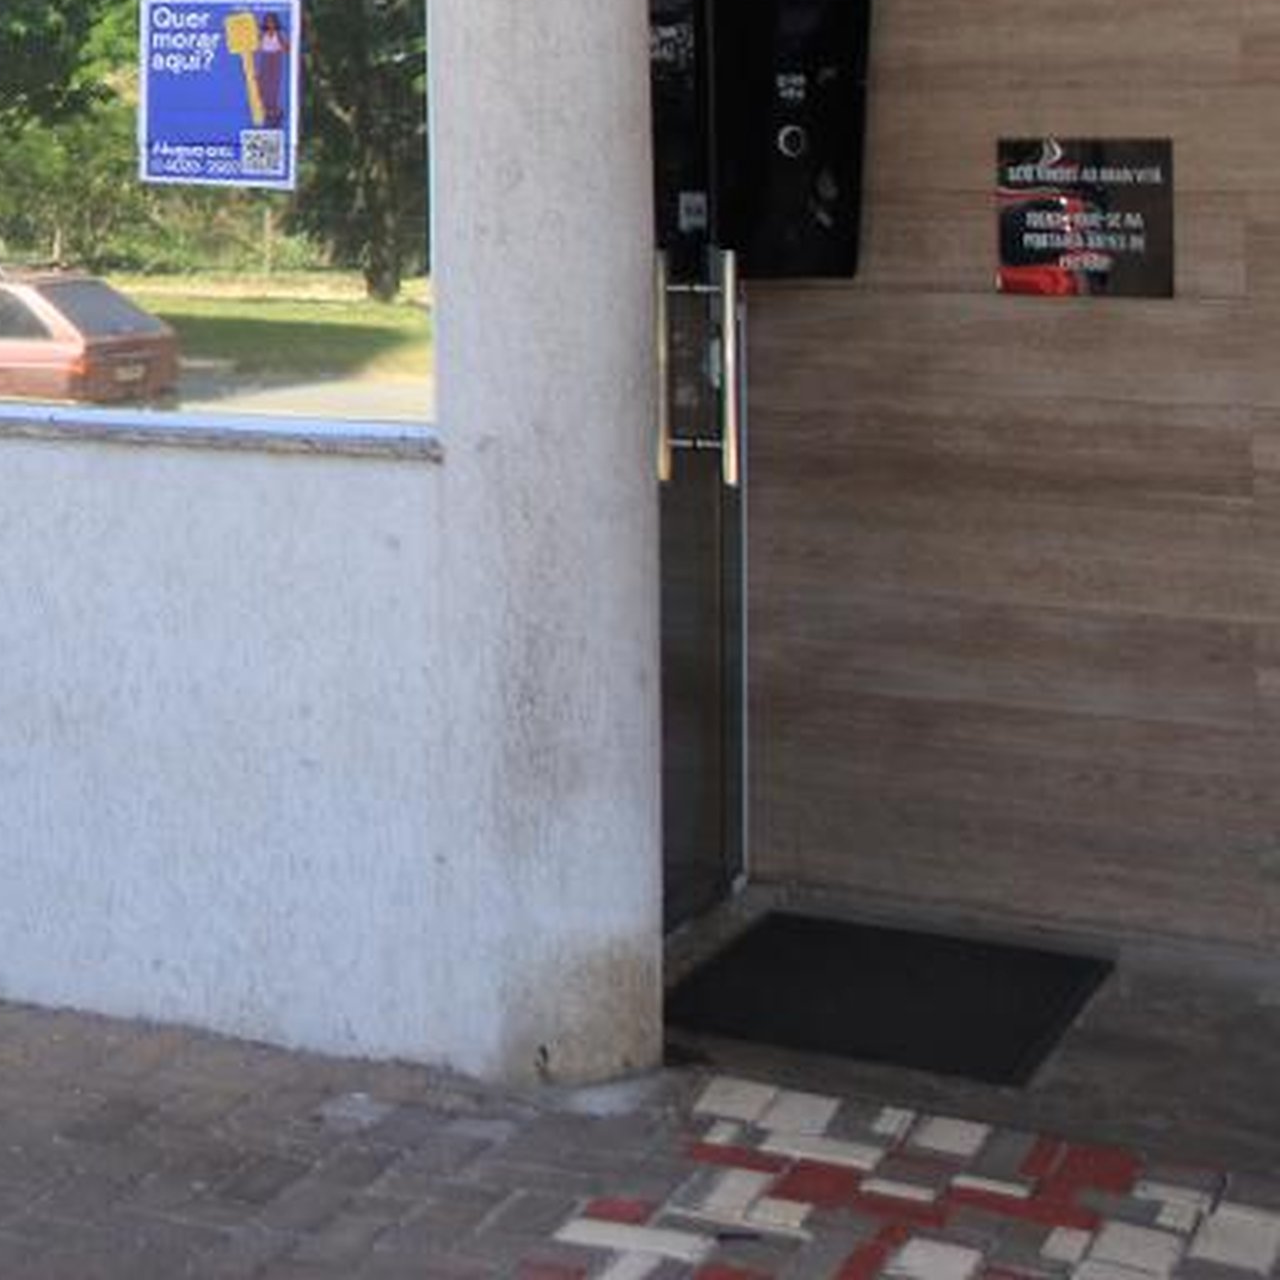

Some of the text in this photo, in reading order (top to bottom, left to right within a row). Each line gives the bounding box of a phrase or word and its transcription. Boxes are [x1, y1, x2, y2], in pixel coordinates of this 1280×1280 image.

[152, 6, 211, 29] Quer
[151, 32, 221, 49] morar
[152, 49, 215, 74] aqui?
